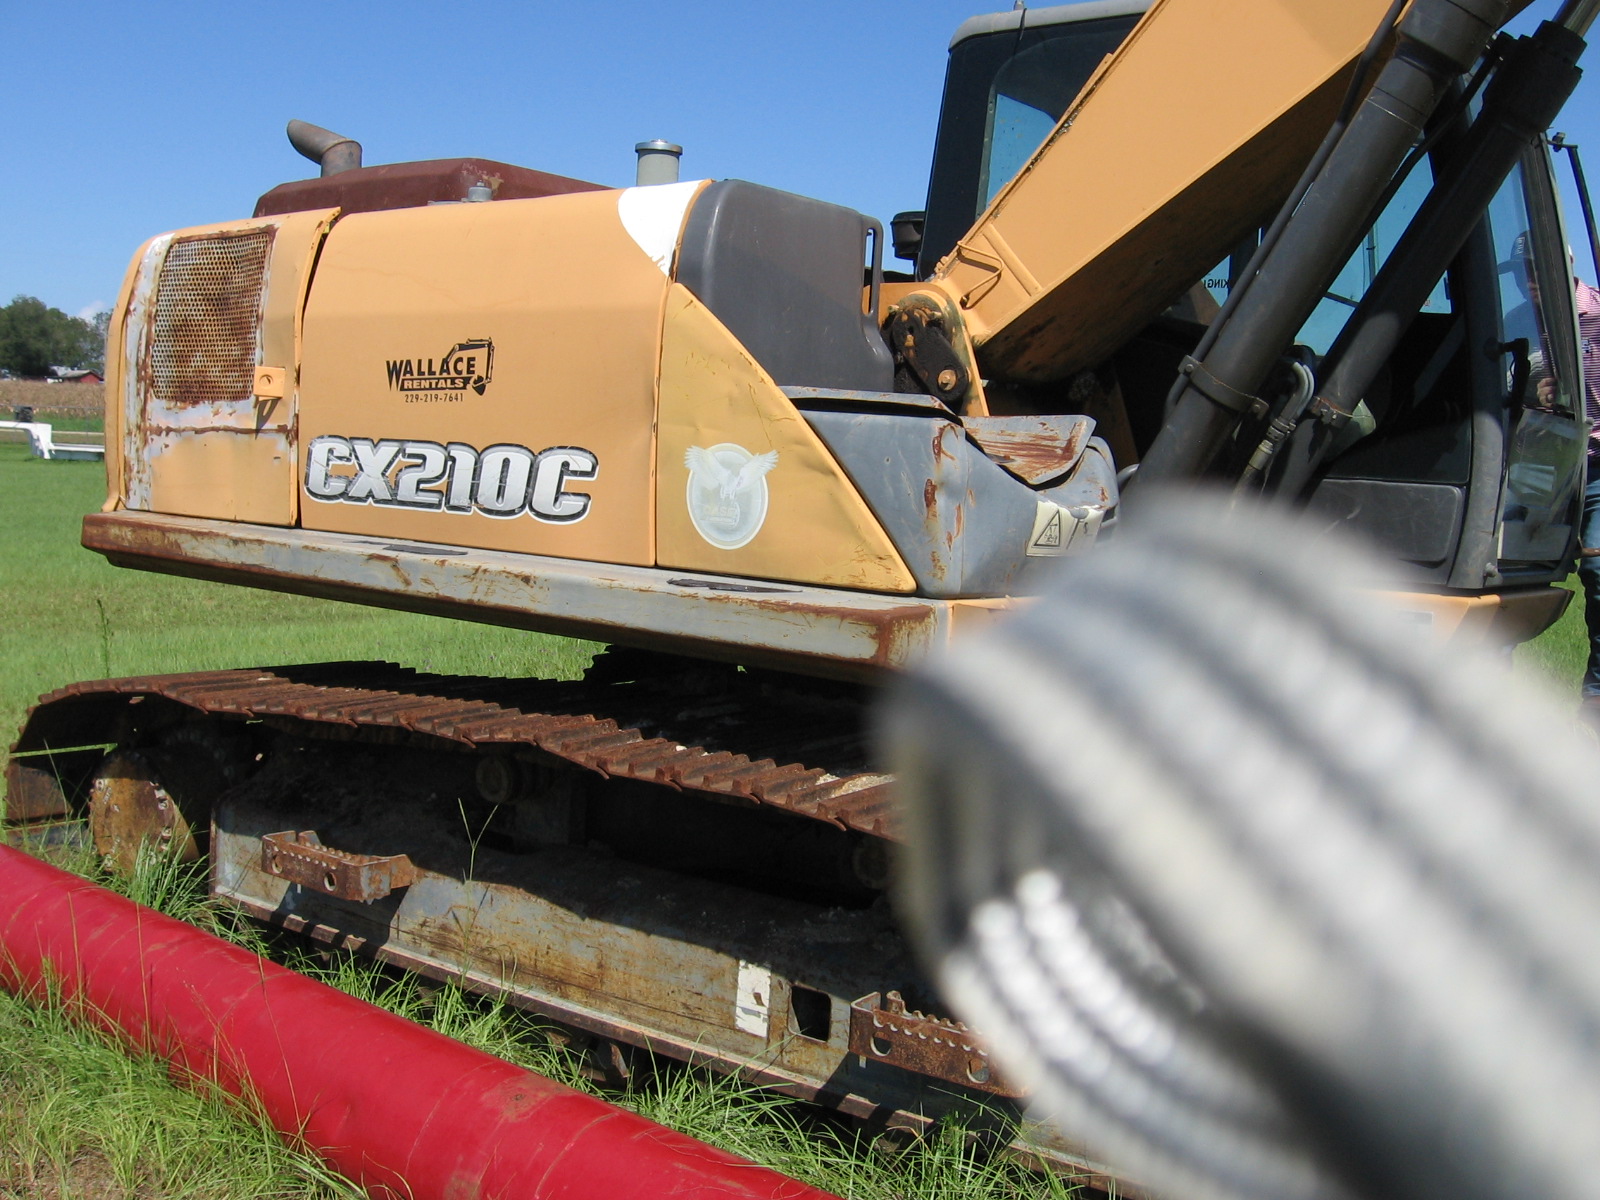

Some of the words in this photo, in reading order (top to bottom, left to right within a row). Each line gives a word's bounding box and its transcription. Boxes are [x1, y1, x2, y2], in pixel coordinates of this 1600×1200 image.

[386, 357, 476, 391] WALLACE
[403, 378, 464, 390] RENTALS
[404, 393, 464, 403] 229-219-7641
[304, 434, 598, 525] CX210C
